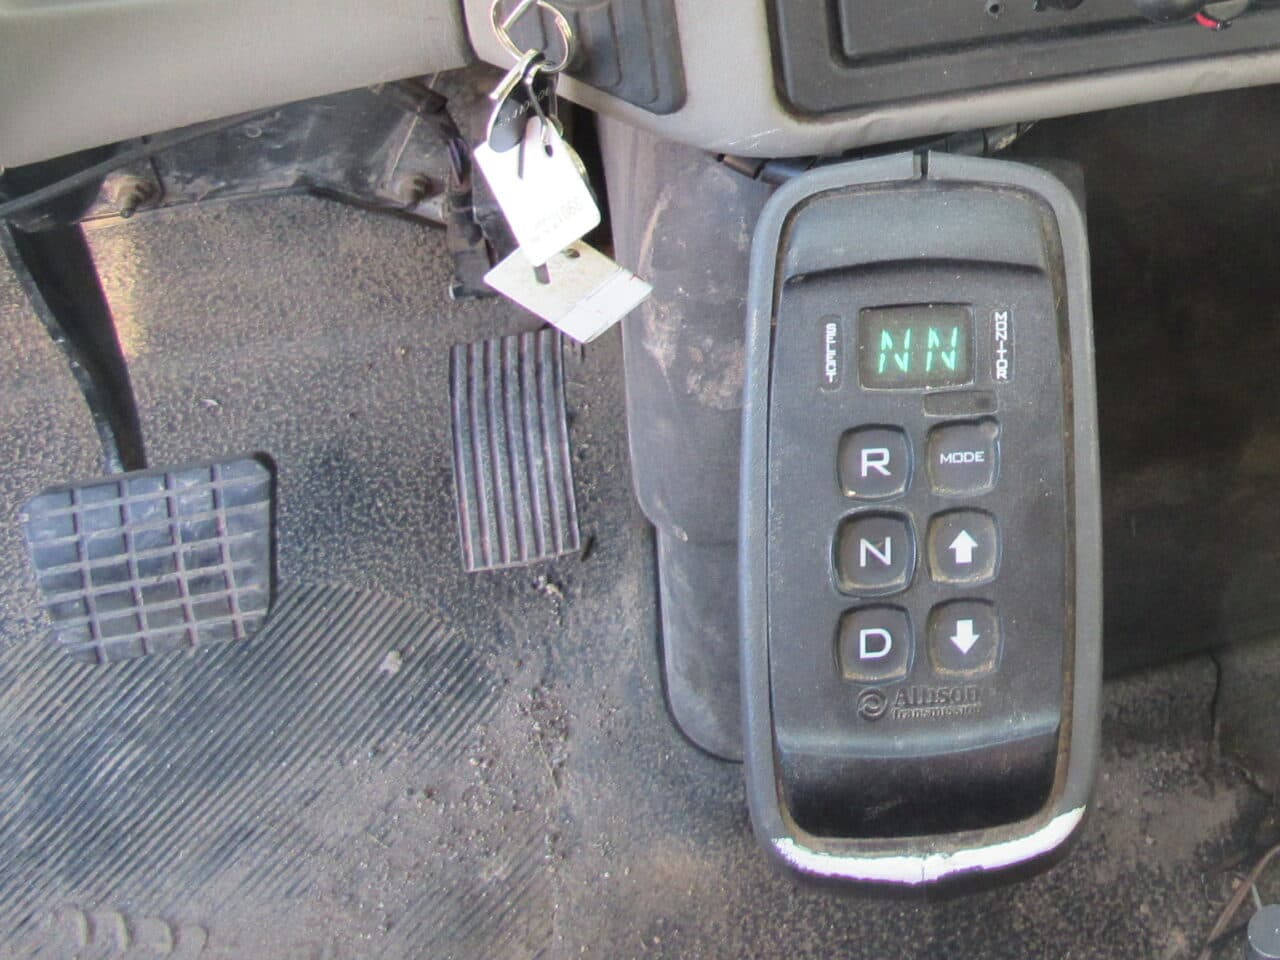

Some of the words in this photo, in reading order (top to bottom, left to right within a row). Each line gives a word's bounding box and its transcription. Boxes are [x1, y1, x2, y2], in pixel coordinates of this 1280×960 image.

[993, 311, 1009, 381] MONITOR
[860, 447, 892, 478] R
[939, 450, 985, 465] MODE
[859, 536, 892, 567] N
[859, 627, 893, 660] D
